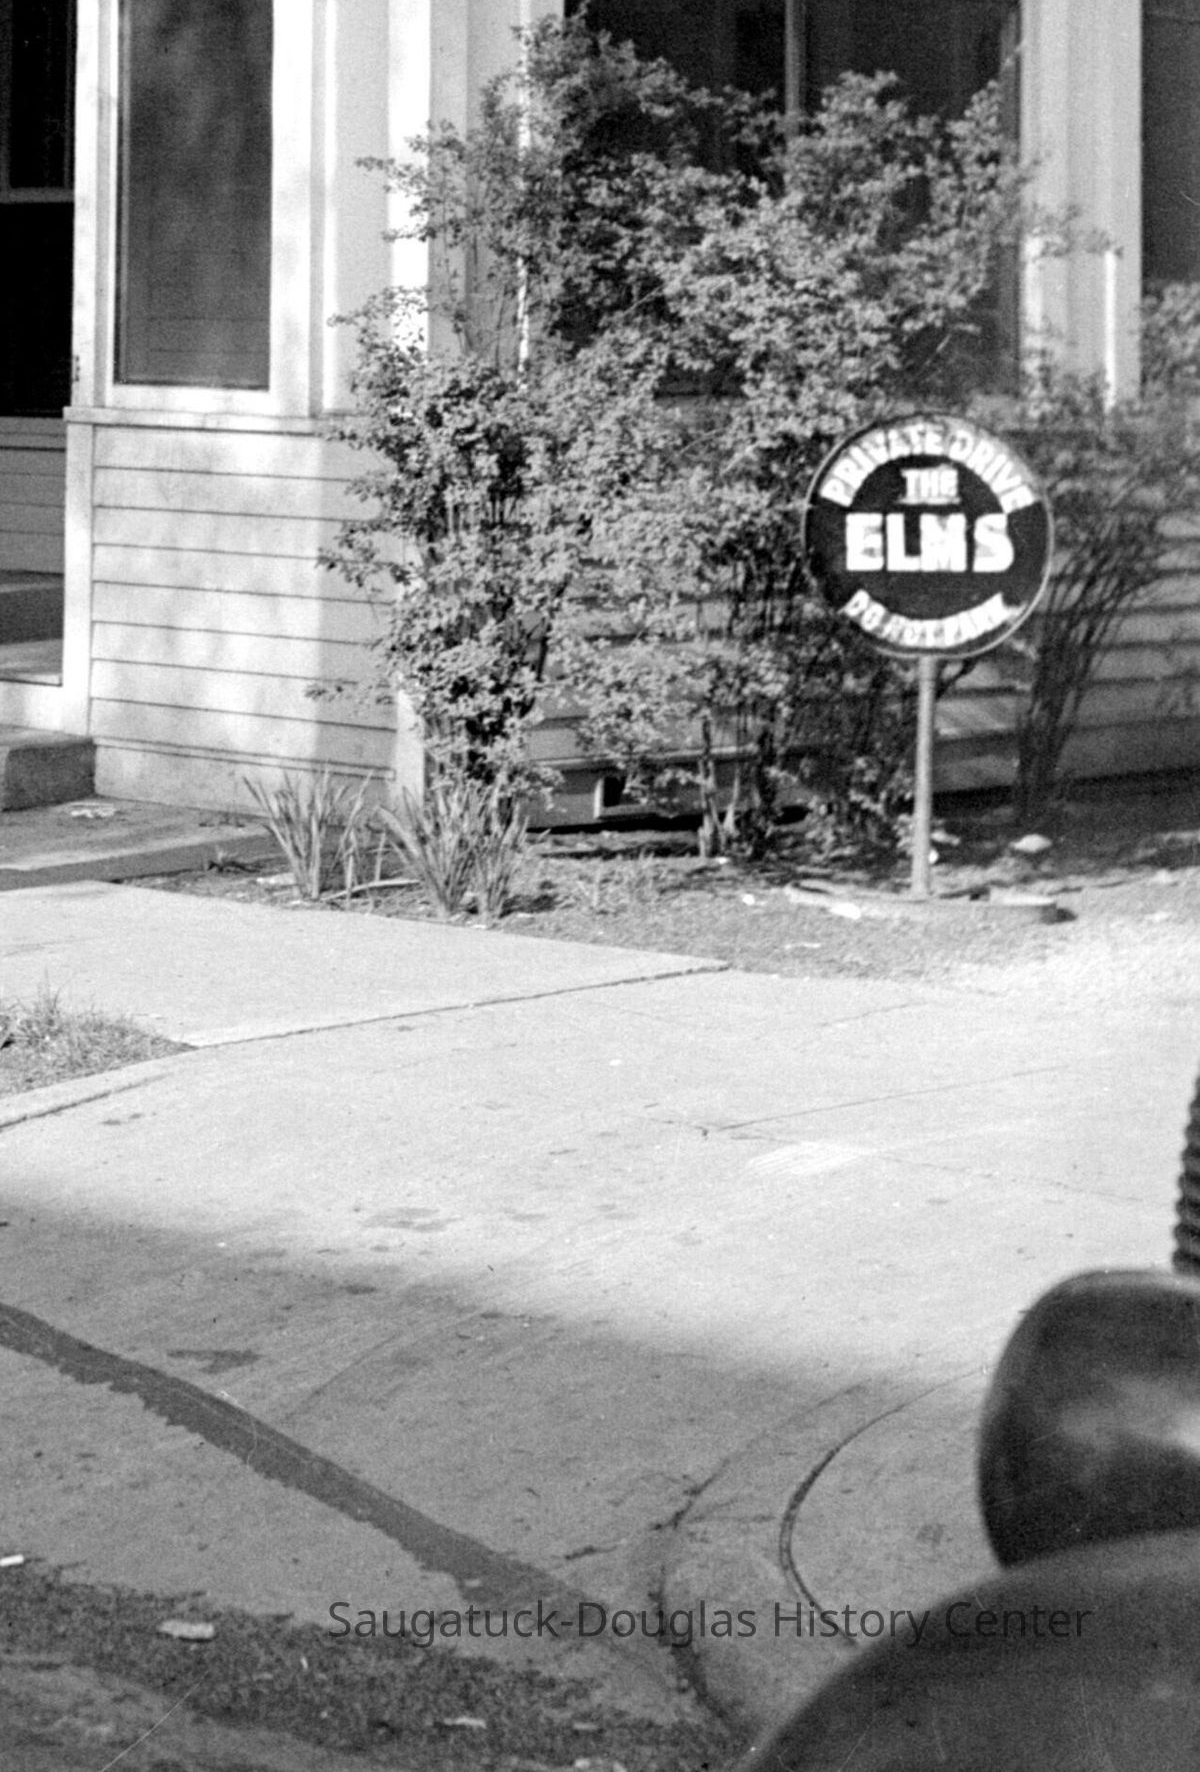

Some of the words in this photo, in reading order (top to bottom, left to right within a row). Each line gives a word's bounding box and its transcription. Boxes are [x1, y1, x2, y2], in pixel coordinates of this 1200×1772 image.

[819, 422, 945, 507] PRIVATE
[946, 427, 1036, 514] DRIVE
[900, 466, 959, 504] THE
[845, 512, 1015, 572] ELMS
[844, 589, 886, 629] DO
[884, 616, 944, 648] NOT
[943, 593, 1021, 646] PARK
